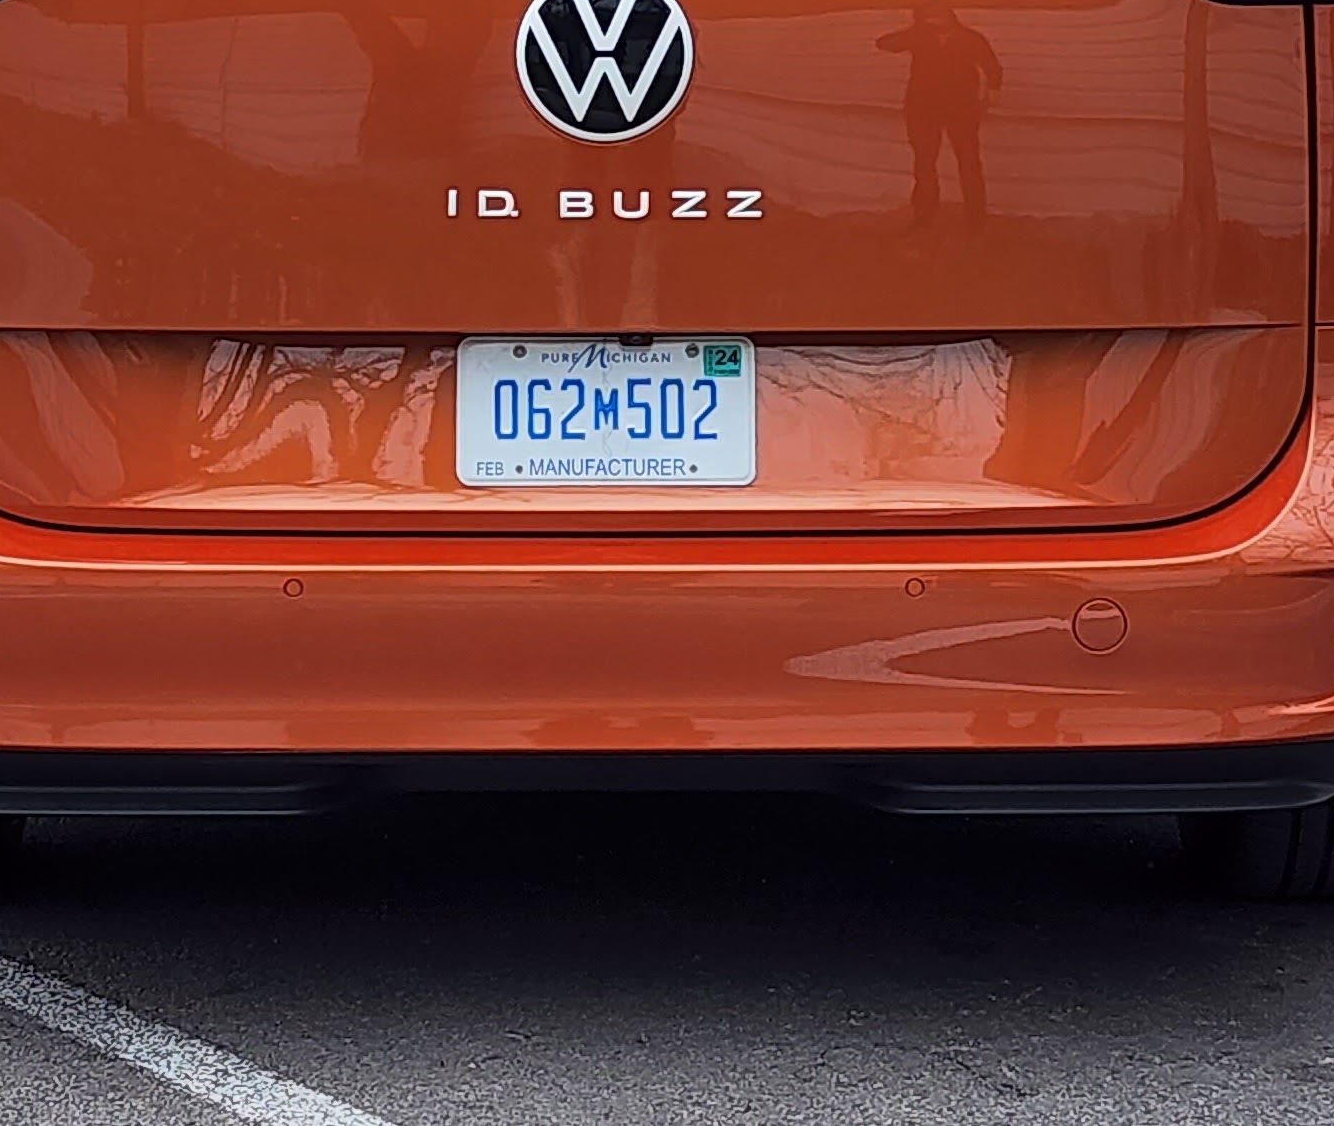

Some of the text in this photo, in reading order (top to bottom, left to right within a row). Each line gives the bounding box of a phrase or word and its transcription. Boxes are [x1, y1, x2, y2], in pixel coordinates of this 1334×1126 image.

[559, 191, 763, 219] BUZZ
[541, 352, 580, 364] PURE
[714, 349, 740, 366] 24
[494, 378, 718, 441] 062M502
[476, 459, 686, 476] FEB MANUFACTURER
